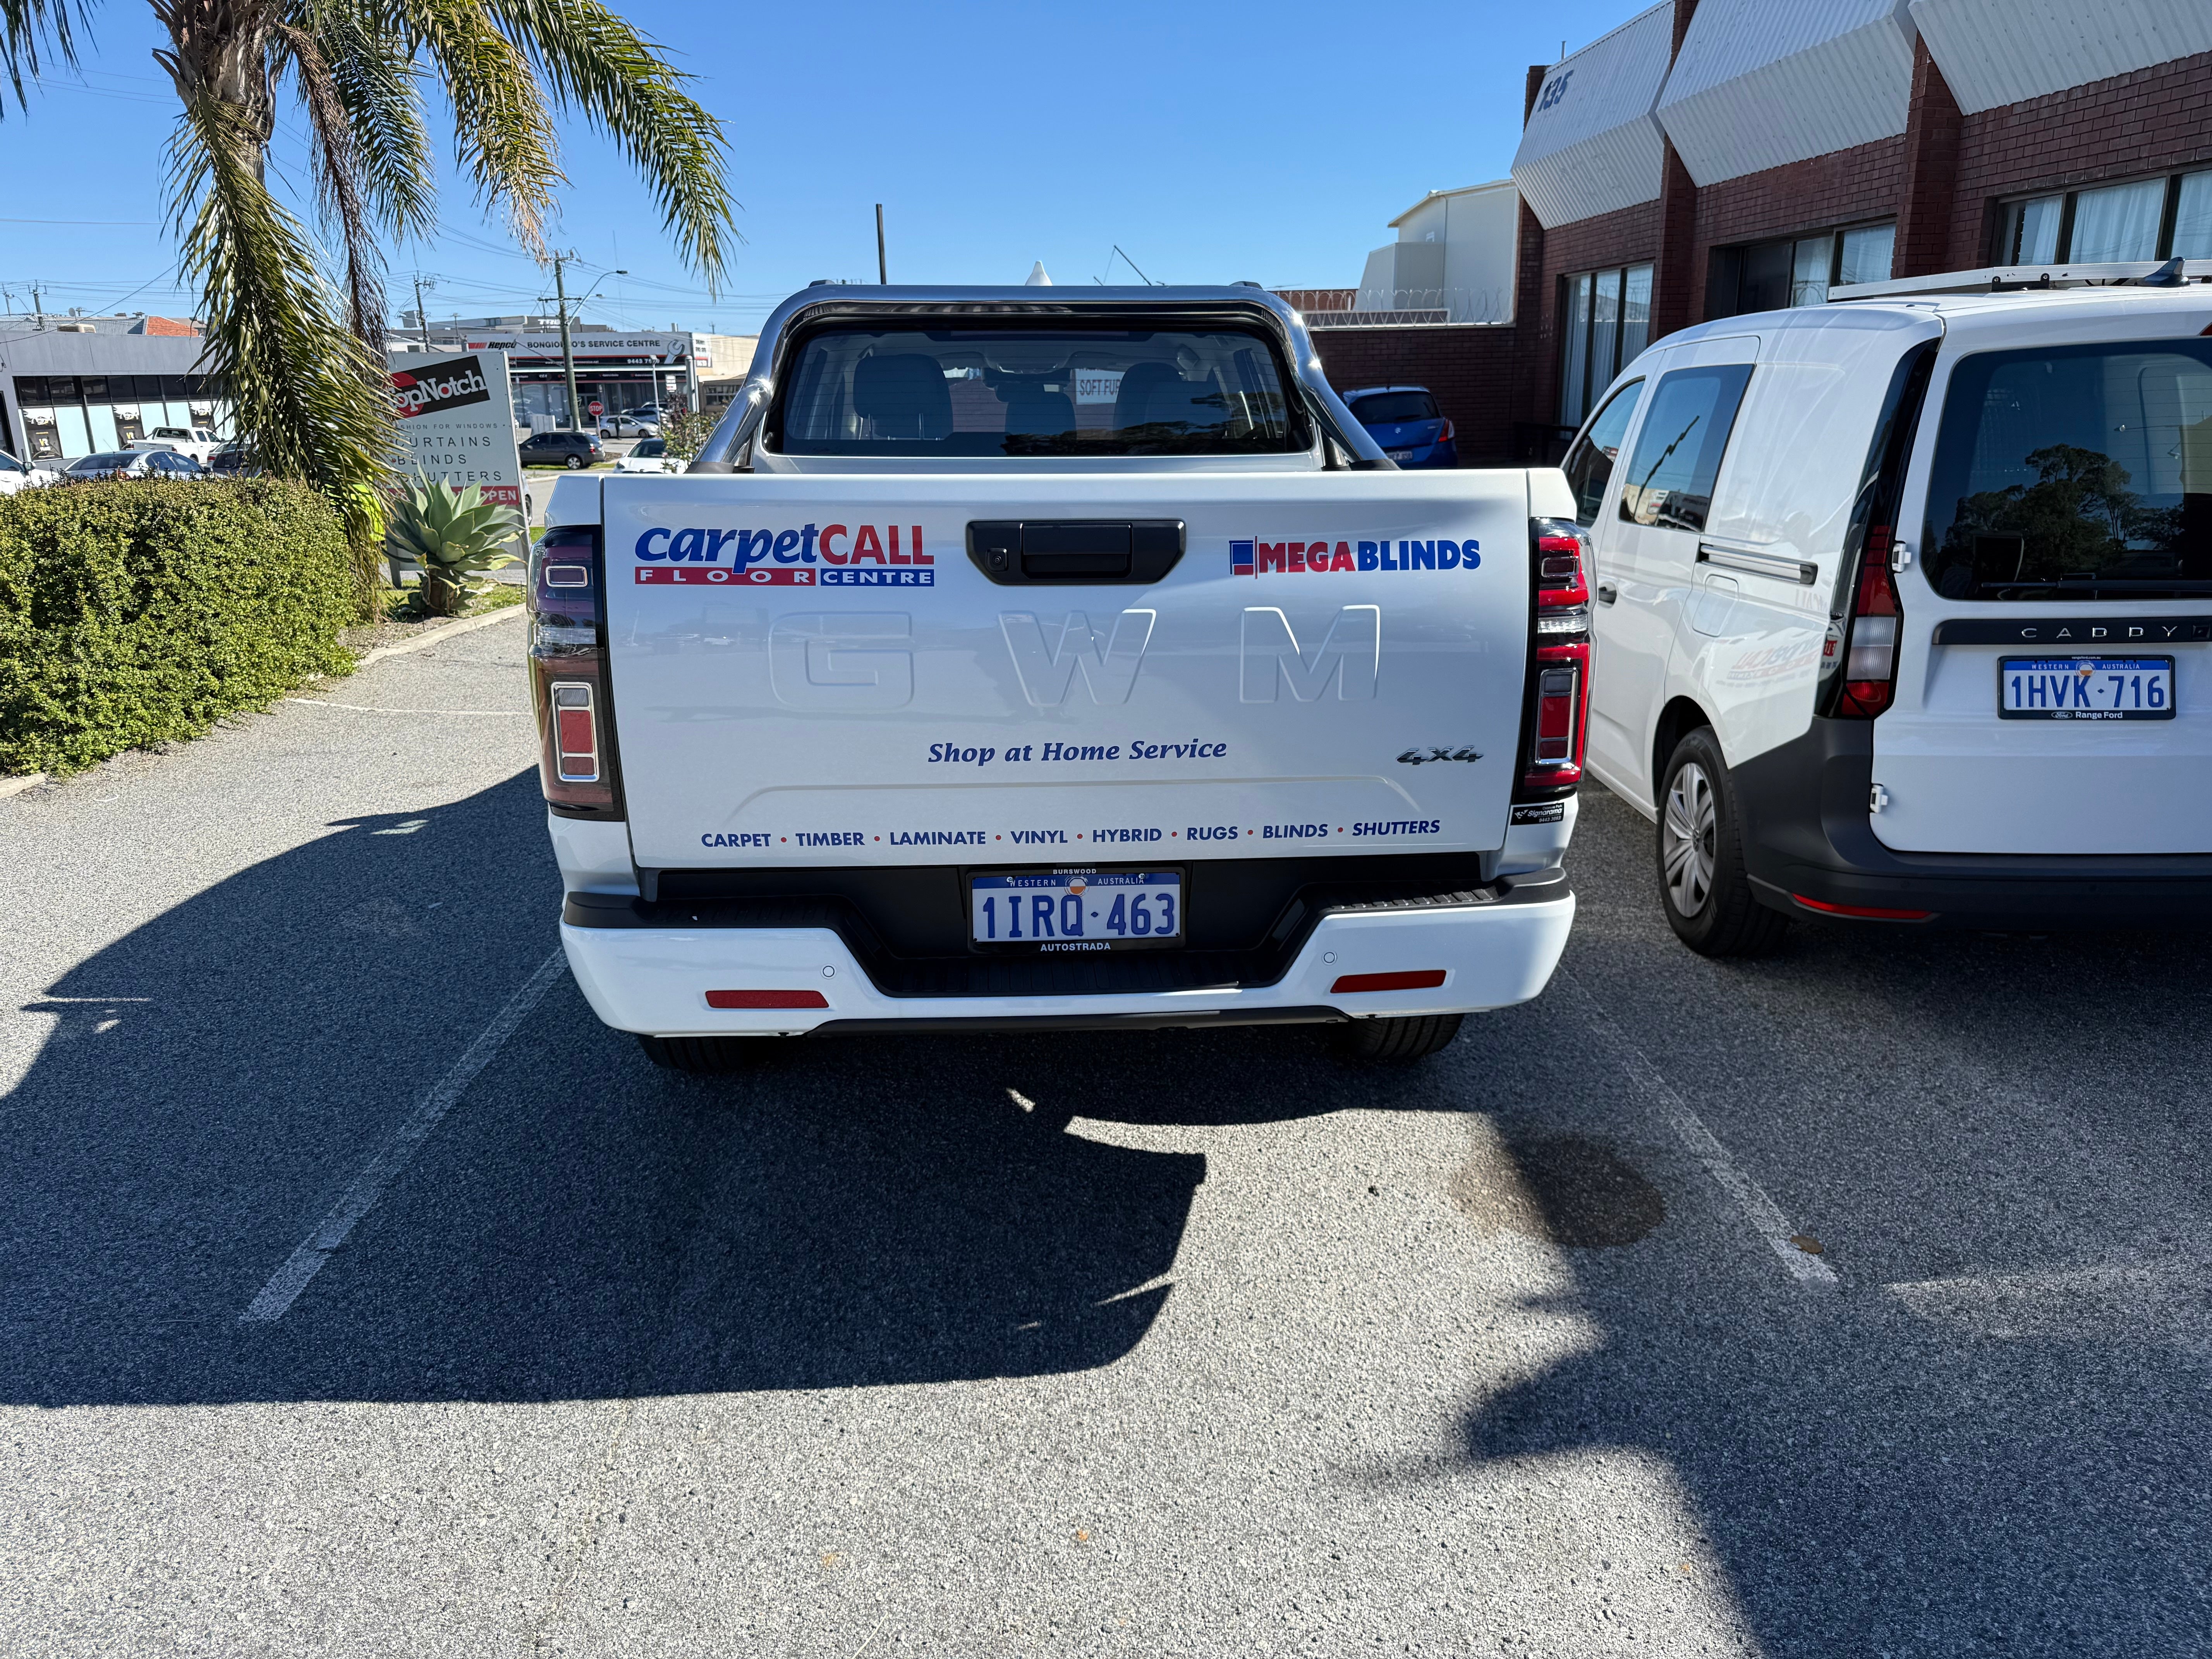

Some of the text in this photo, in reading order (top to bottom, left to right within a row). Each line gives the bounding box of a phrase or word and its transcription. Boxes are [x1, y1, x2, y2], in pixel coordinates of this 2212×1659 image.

[488, 341, 517, 350] Repco
[1079, 379, 1102, 396] SOFT
[395, 436, 491, 447] CURTAINS
[398, 454, 467, 465] BLINDS
[404, 471, 501, 482] HUTTERS
[635, 523, 934, 574] carpetCALL
[640, 570, 931, 584] FLOOR CENTRE
[2021, 626, 2177, 639] CADDY
[2075, 711, 2102, 720] Range
[928, 738, 1227, 767] Shop at Home Service
[1527, 808, 1562, 818] Signarama
[701, 819, 1441, 847] CARPET TIMBER LAMINATE VINYL HYBRID RUGS BLINDS SHUTTERS
[1010, 877, 1144, 887] WESTERN AUSTRALIA
[1040, 942, 1111, 952] AUTOSTRADA
